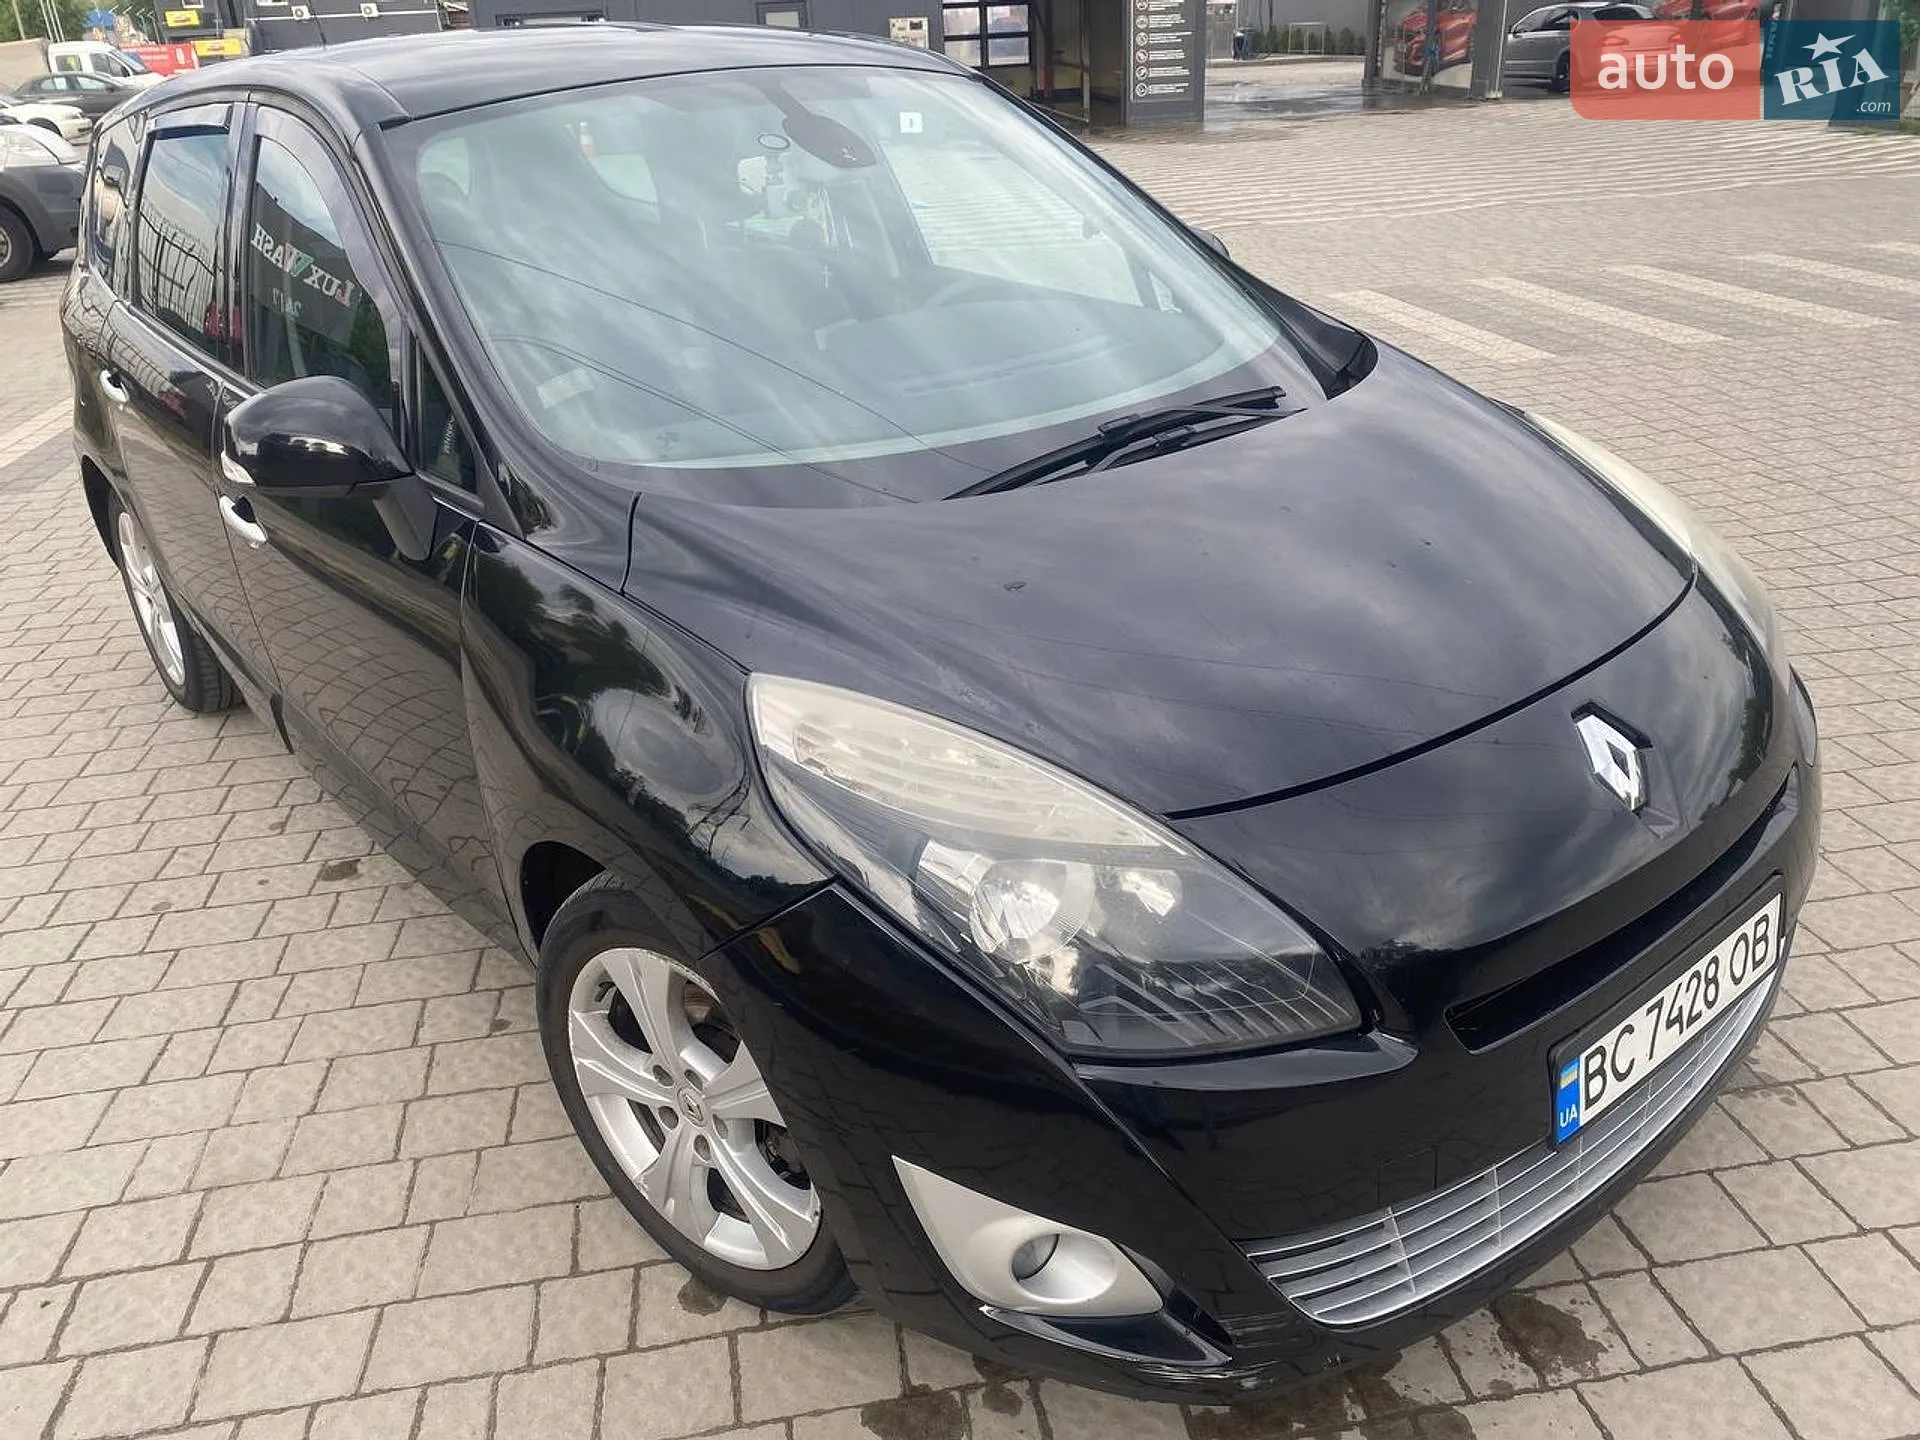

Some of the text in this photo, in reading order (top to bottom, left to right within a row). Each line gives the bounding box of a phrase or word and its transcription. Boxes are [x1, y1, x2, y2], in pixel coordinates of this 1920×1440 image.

[1584, 914, 1770, 1110] BC 7428 OB
[1560, 1103, 1578, 1128] UA
